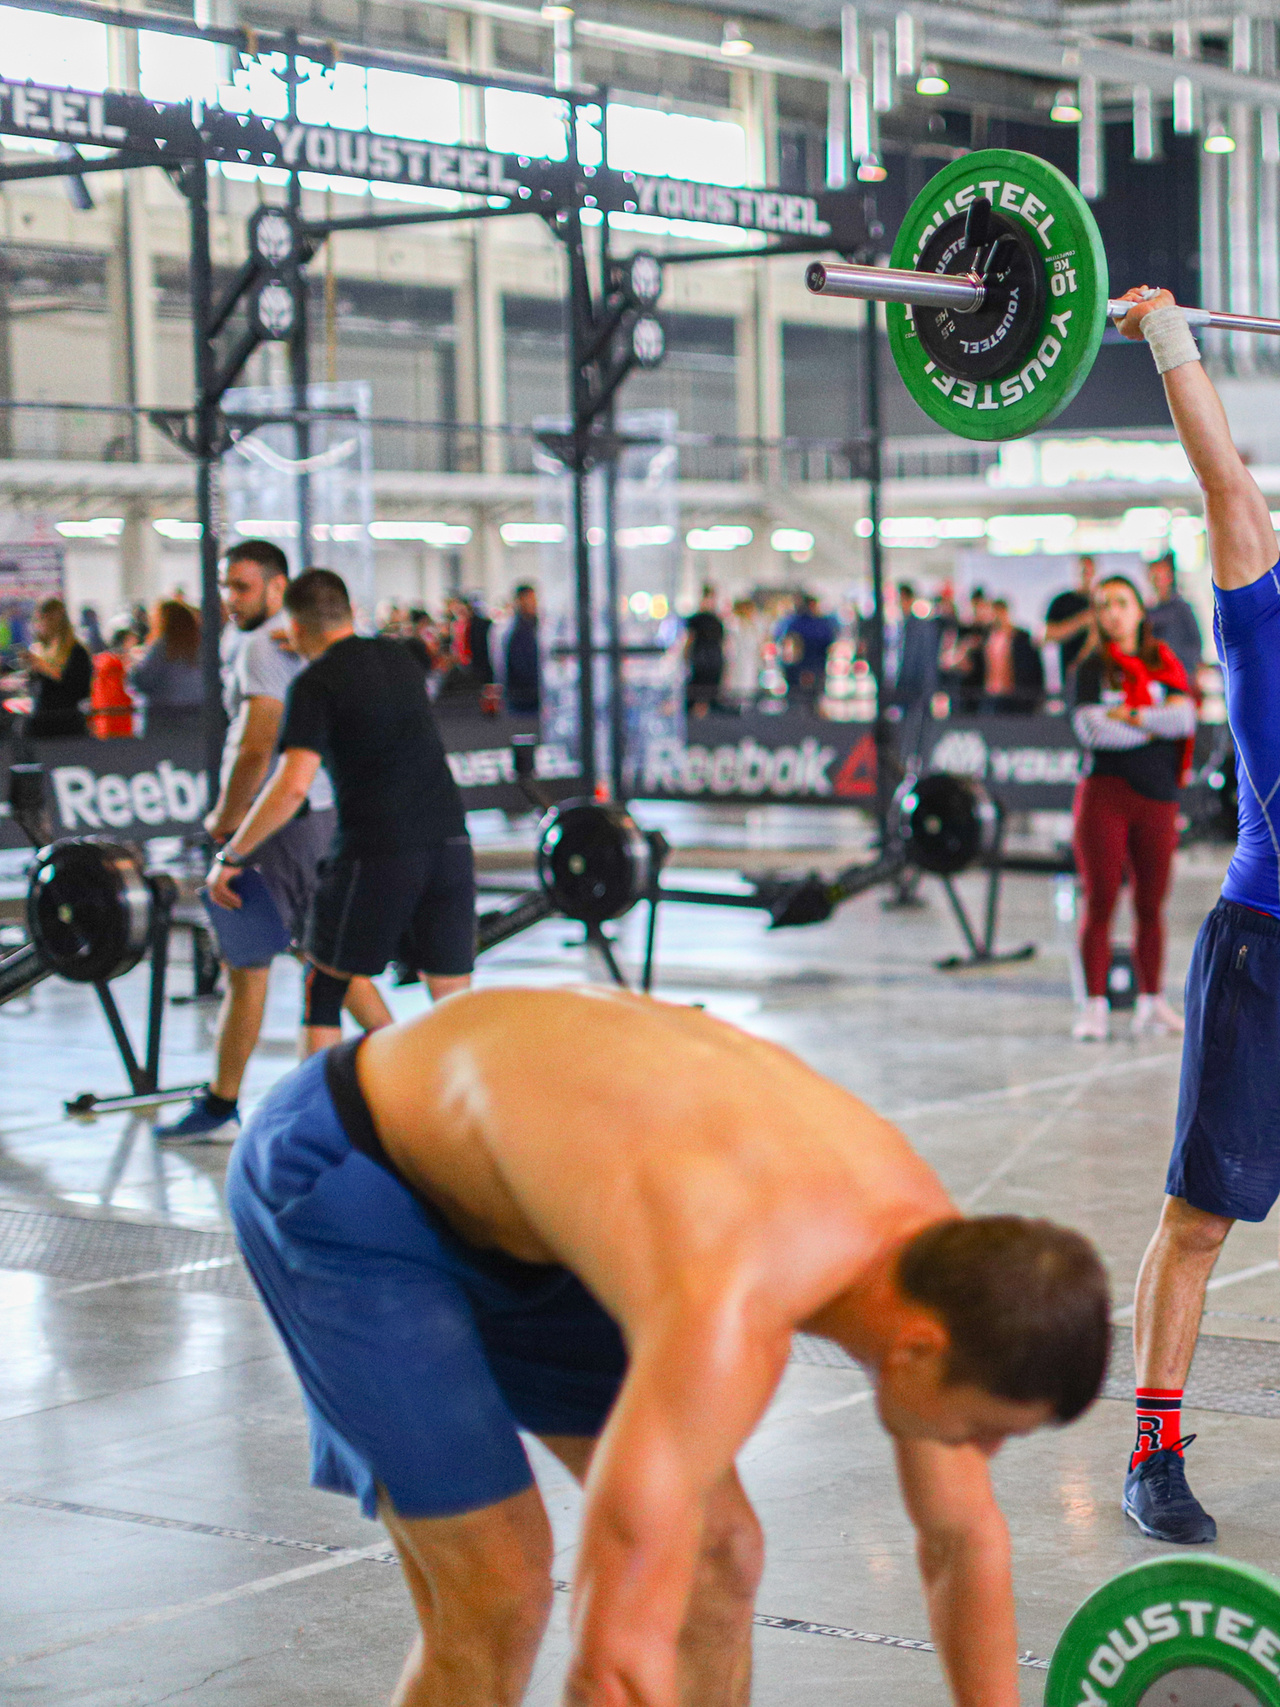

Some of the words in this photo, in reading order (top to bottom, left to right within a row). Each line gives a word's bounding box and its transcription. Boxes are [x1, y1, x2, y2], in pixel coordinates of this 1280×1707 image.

[0, 82, 127, 142] EEL
[273, 121, 521, 195] YOUSTEEL
[632, 176, 832, 237] YOUSTEEL
[1051, 269, 1077, 297] 10
[1053, 258, 1070, 272] KG
[959, 287, 1020, 354] YOUSTEEL
[51, 760, 209, 831] Reeb
[643, 736, 837, 796] Reebok
[1135, 1415, 1163, 1452] R
[806, 1624, 936, 1650] YOUSTEE
